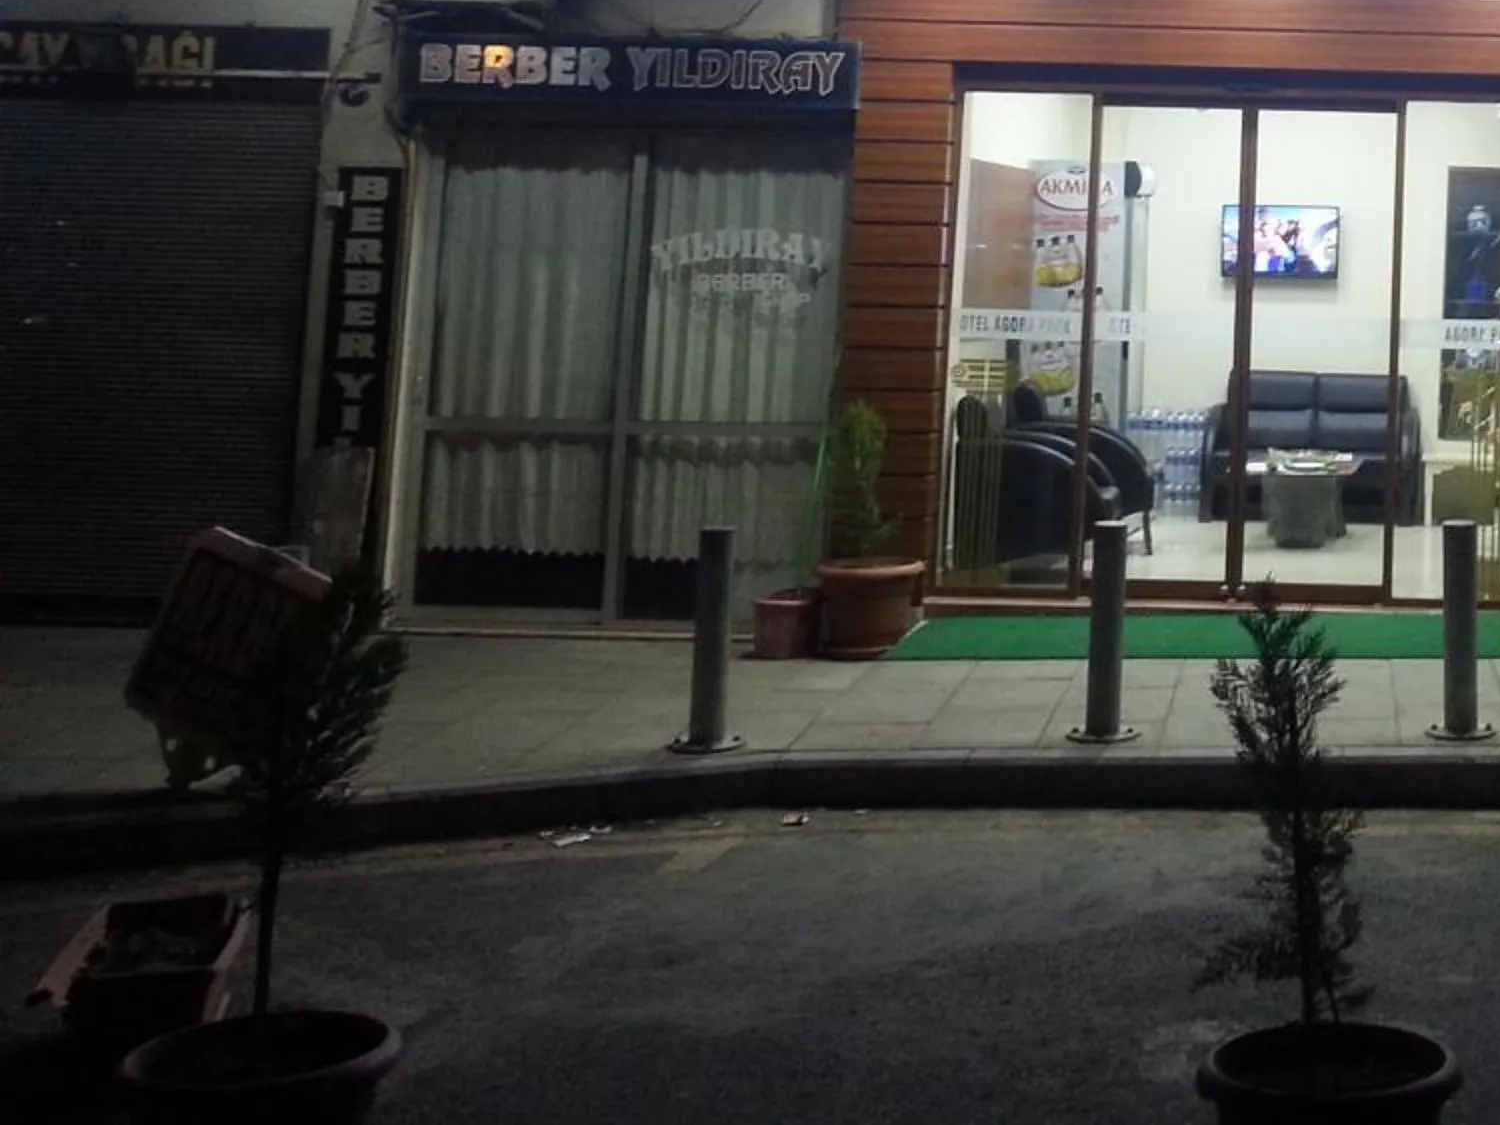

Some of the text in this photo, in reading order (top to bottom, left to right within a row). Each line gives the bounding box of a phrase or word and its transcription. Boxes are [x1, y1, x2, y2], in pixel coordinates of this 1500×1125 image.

[419, 42, 846, 97] BERBER YILDIRAY
[651, 228, 830, 272] YILDIRAY
[331, 175, 389, 447] BERBER YI
